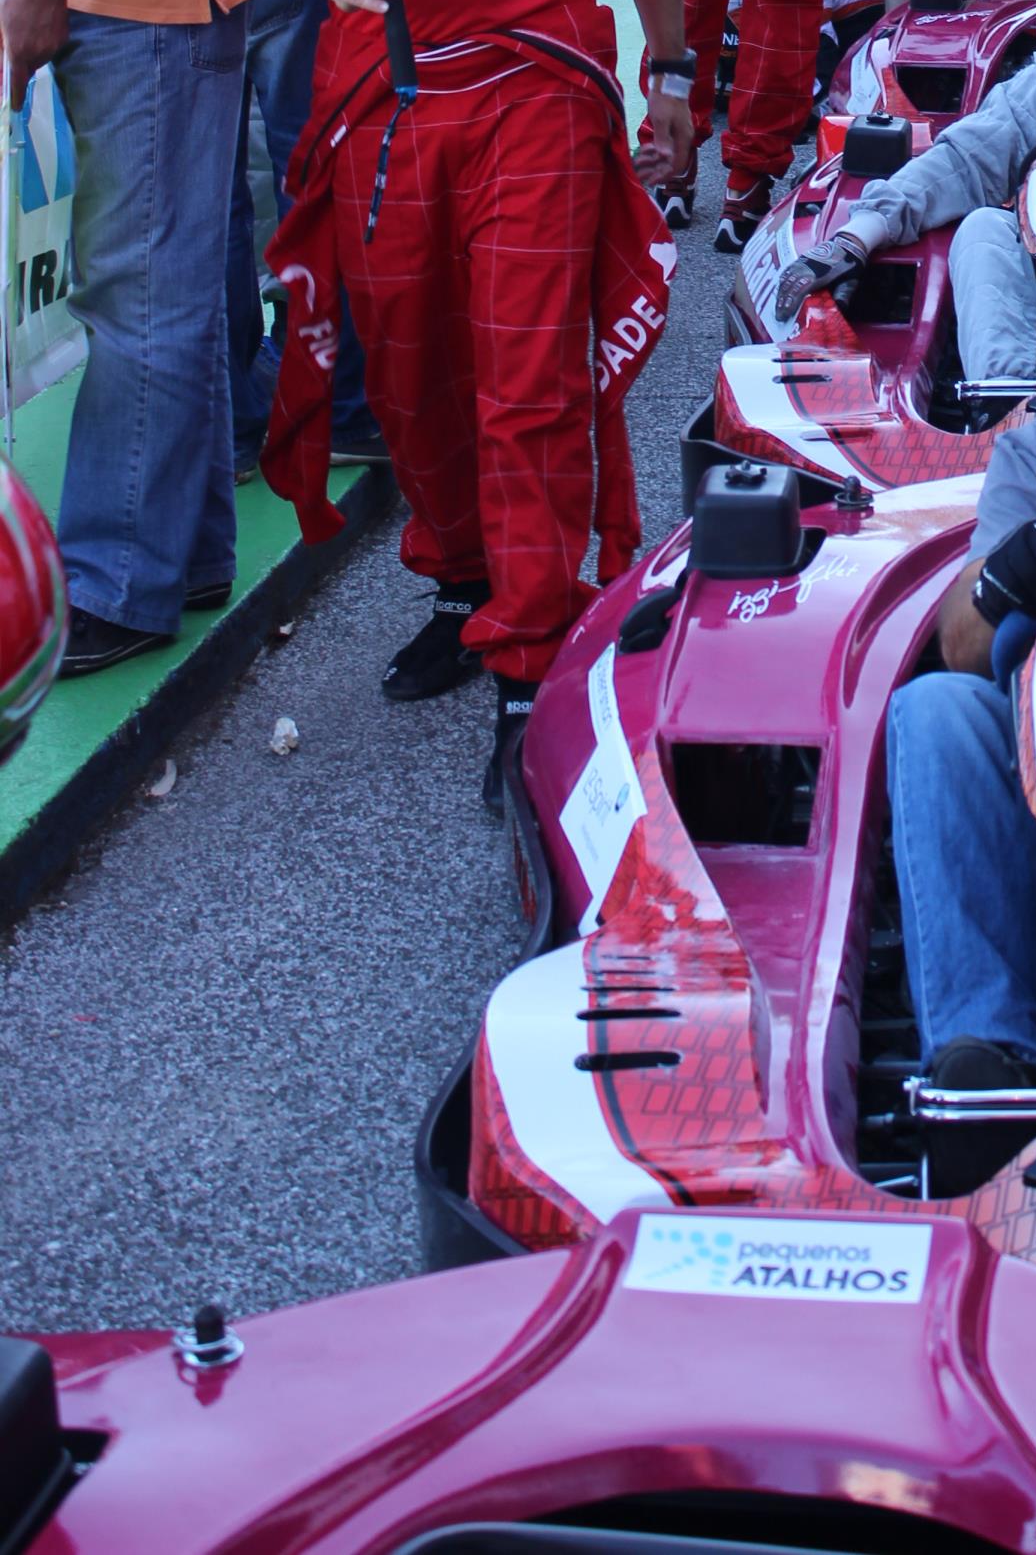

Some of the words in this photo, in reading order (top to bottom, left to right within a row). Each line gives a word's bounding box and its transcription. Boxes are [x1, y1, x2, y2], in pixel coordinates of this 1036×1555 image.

[505, 701, 535, 715] spar
[737, 1241, 871, 1264] pequenos
[731, 1265, 910, 1293] ATALHOS
